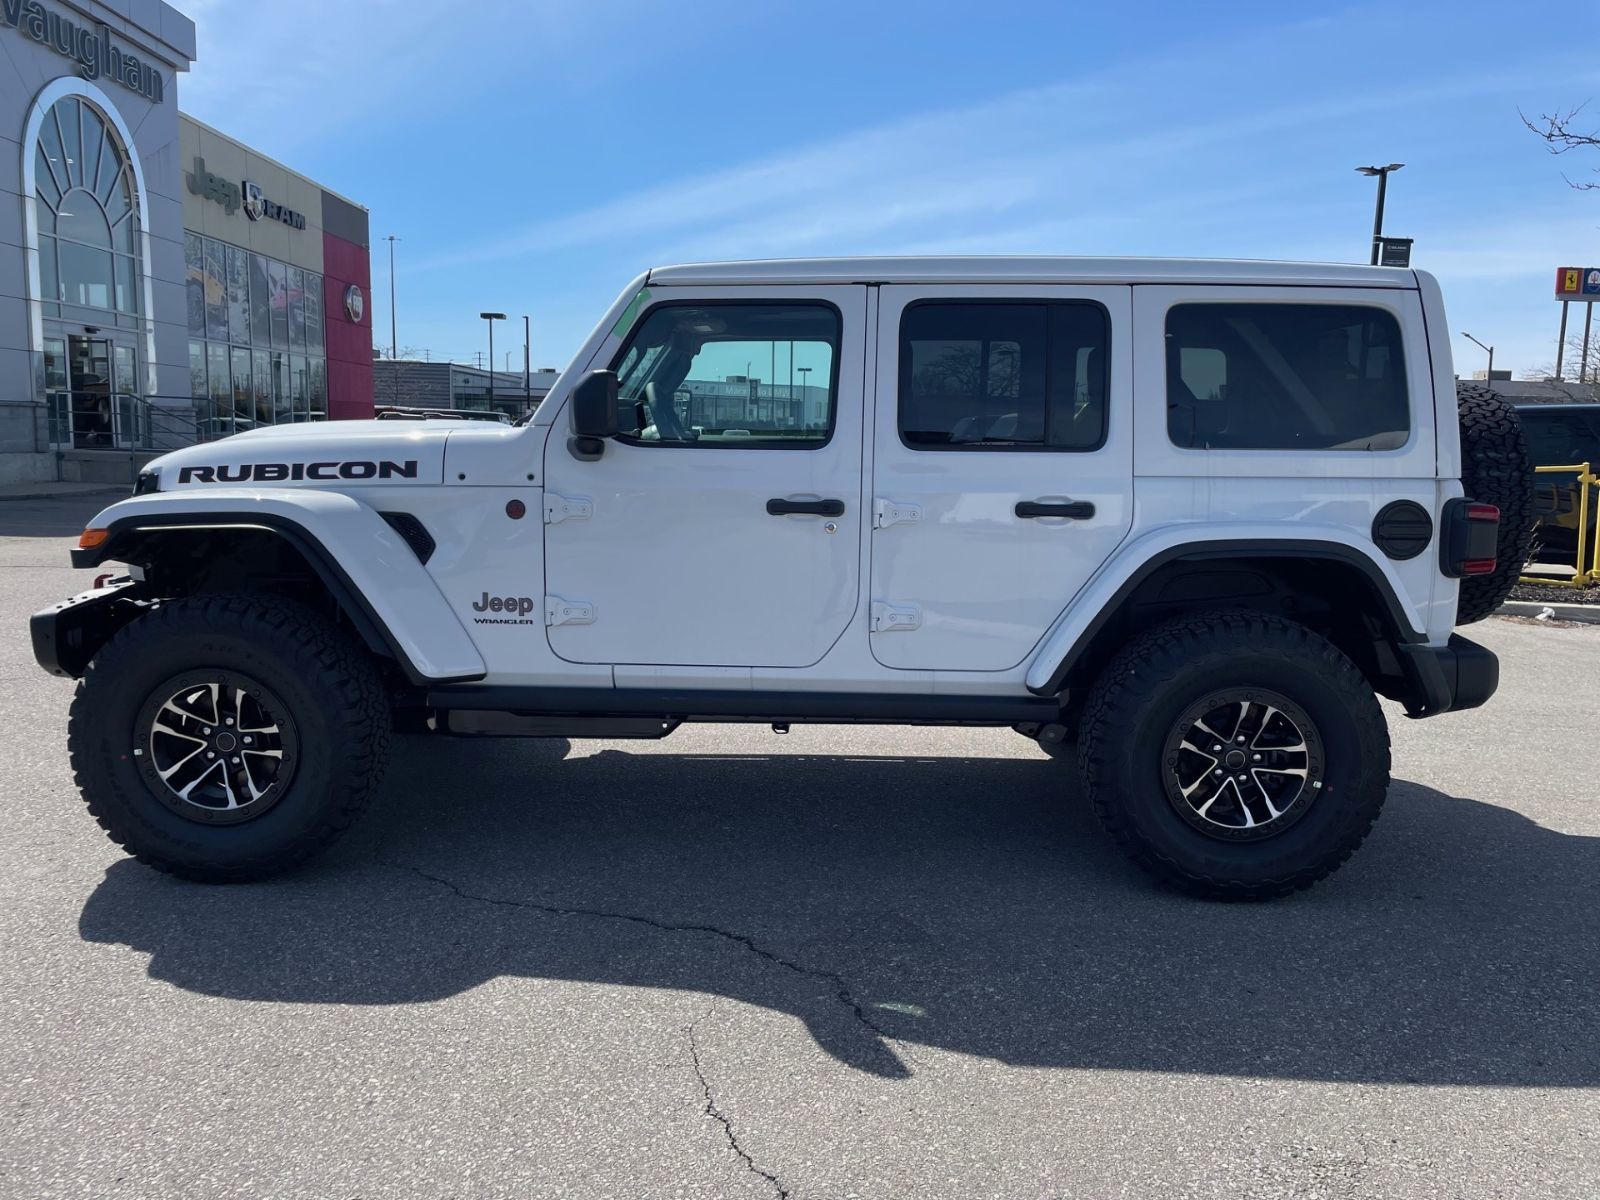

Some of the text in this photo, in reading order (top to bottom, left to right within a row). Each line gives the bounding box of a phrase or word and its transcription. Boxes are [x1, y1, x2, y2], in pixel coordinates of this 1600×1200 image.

[186, 157, 240, 216] Jeep
[264, 200, 305, 230] RAM
[178, 461, 417, 483] RUBICON
[473, 592, 533, 616] Jeep
